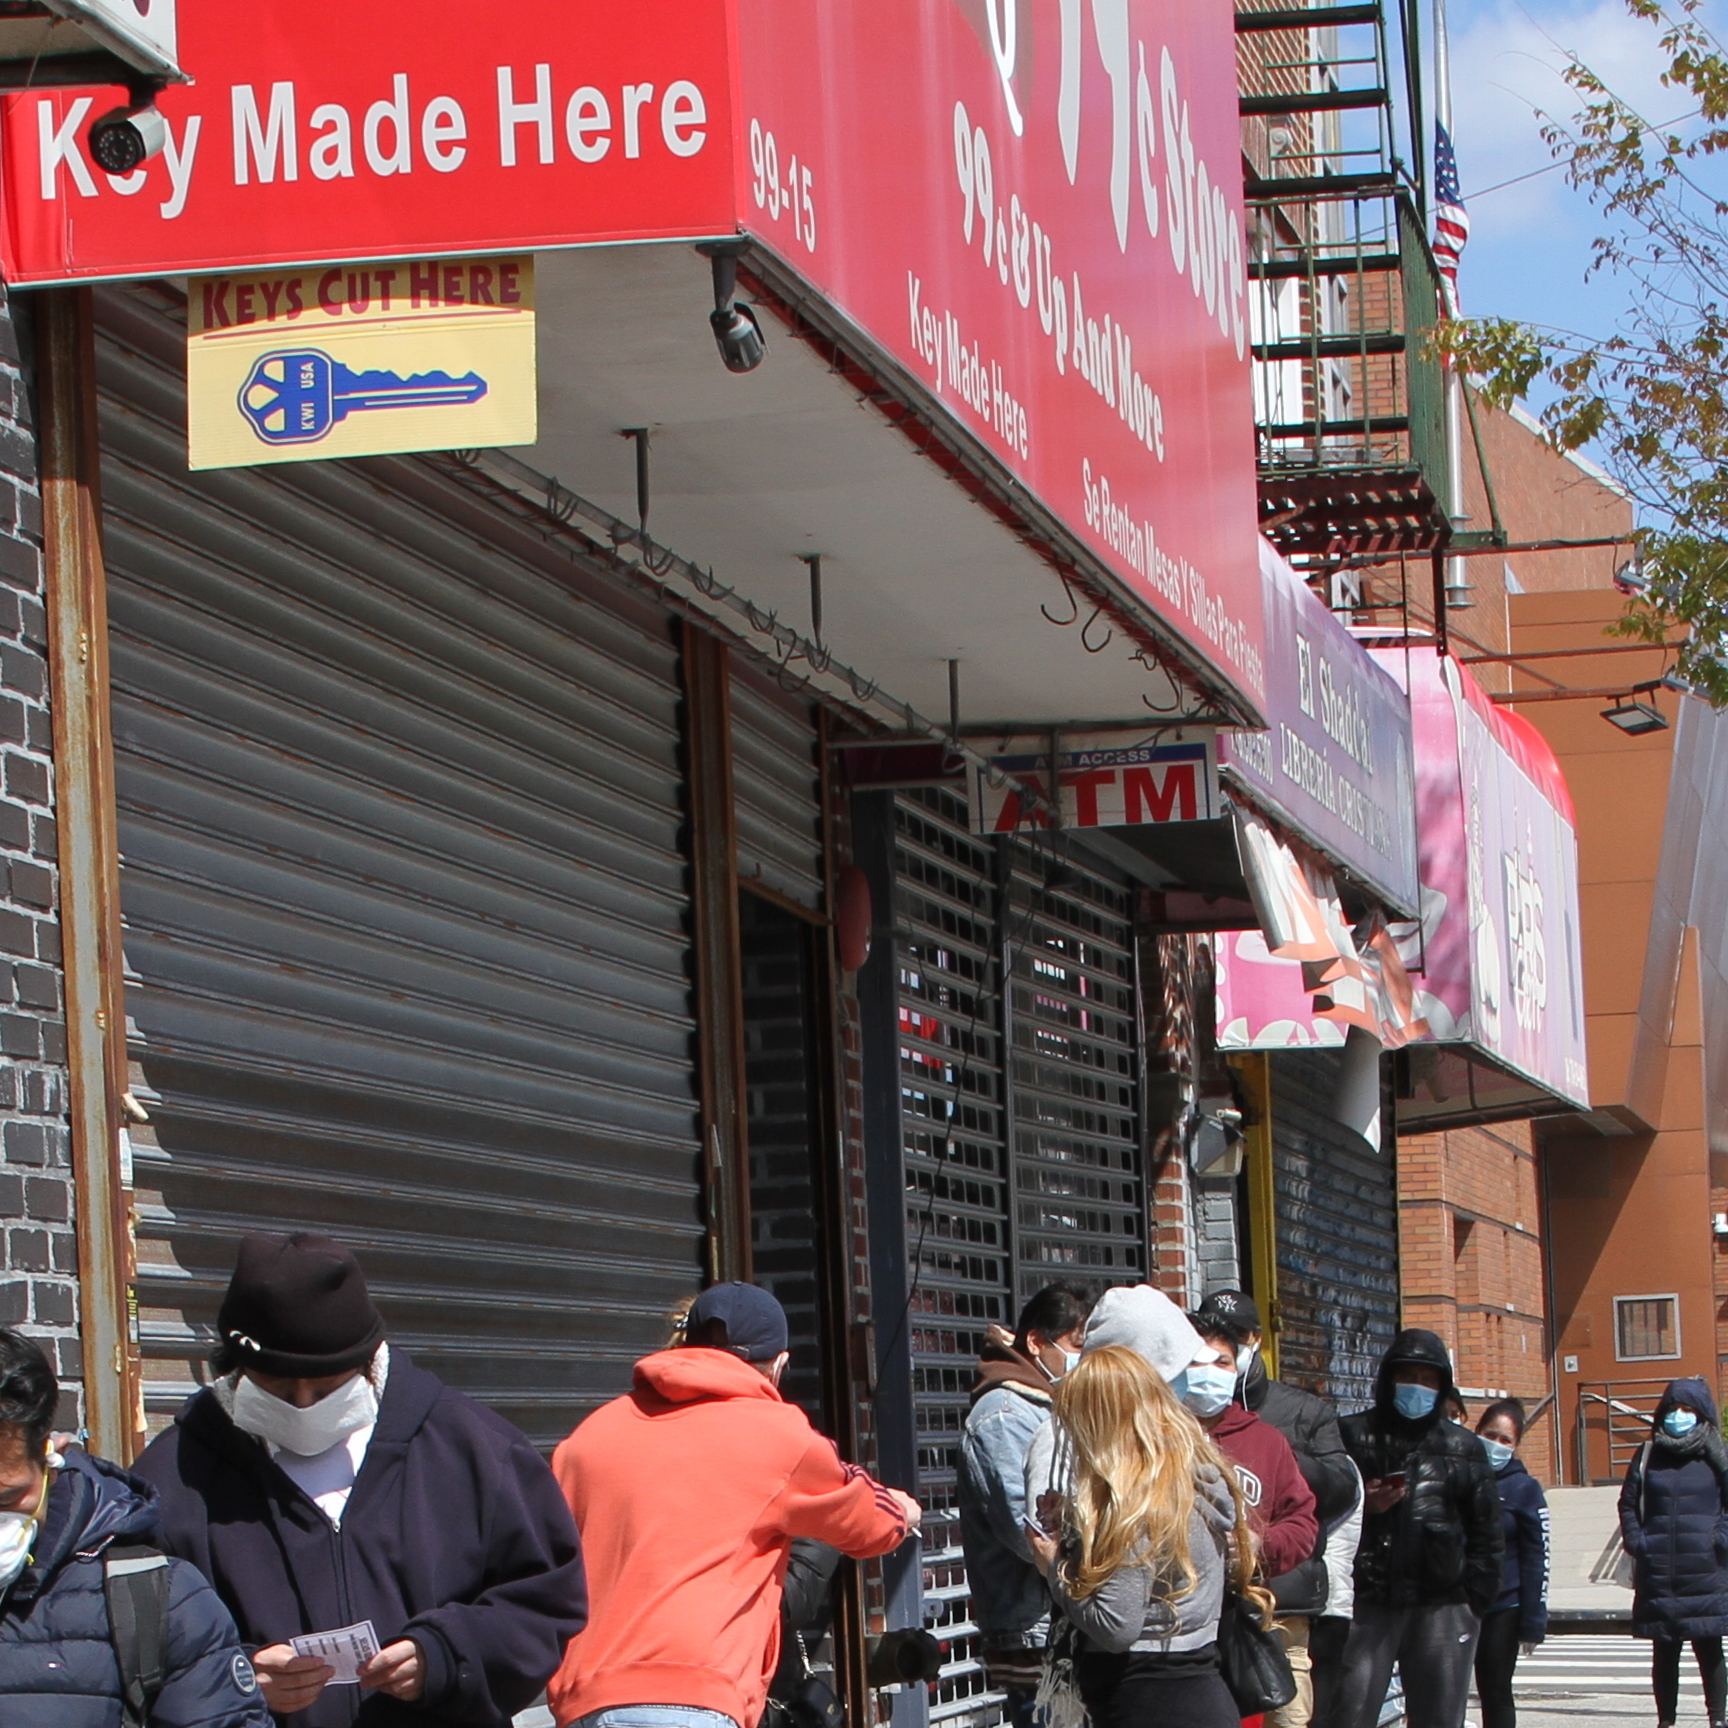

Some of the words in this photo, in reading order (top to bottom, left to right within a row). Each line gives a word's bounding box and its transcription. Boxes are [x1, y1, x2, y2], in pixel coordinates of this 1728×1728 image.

[230, 73, 468, 187] Made
[495, 63, 707, 168] Here
[750, 117, 816, 253] 99-15
[1161, 45, 1245, 362] Store
[202, 278, 303, 330] KEYS
[317, 267, 396, 317] CUT
[409, 261, 521, 310] HERE
[1011, 193, 1031, 308] &
[1033, 222, 1068, 375] Up
[1073, 270, 1115, 408] And
[1115, 323, 1164, 462] More
[300, 361, 315, 389] USA
[301, 402, 315, 431] KWI
[907, 270, 942, 393] Key
[945, 309, 990, 423] Made
[991, 359, 1028, 461] Here
[1082, 457, 1100, 534] Se
[1101, 475, 1145, 577] Rentan
[1144, 520, 1181, 610] Mesas
[1179, 555, 1189, 617] Y
[1189, 566, 1218, 646] Sillas
[1217, 594, 1239, 668] Para
[1296, 633, 1315, 721] El
[993, 764, 1198, 832] ATM
[1034, 754, 1072, 769] AM
[1078, 749, 1150, 766] ACCESS
